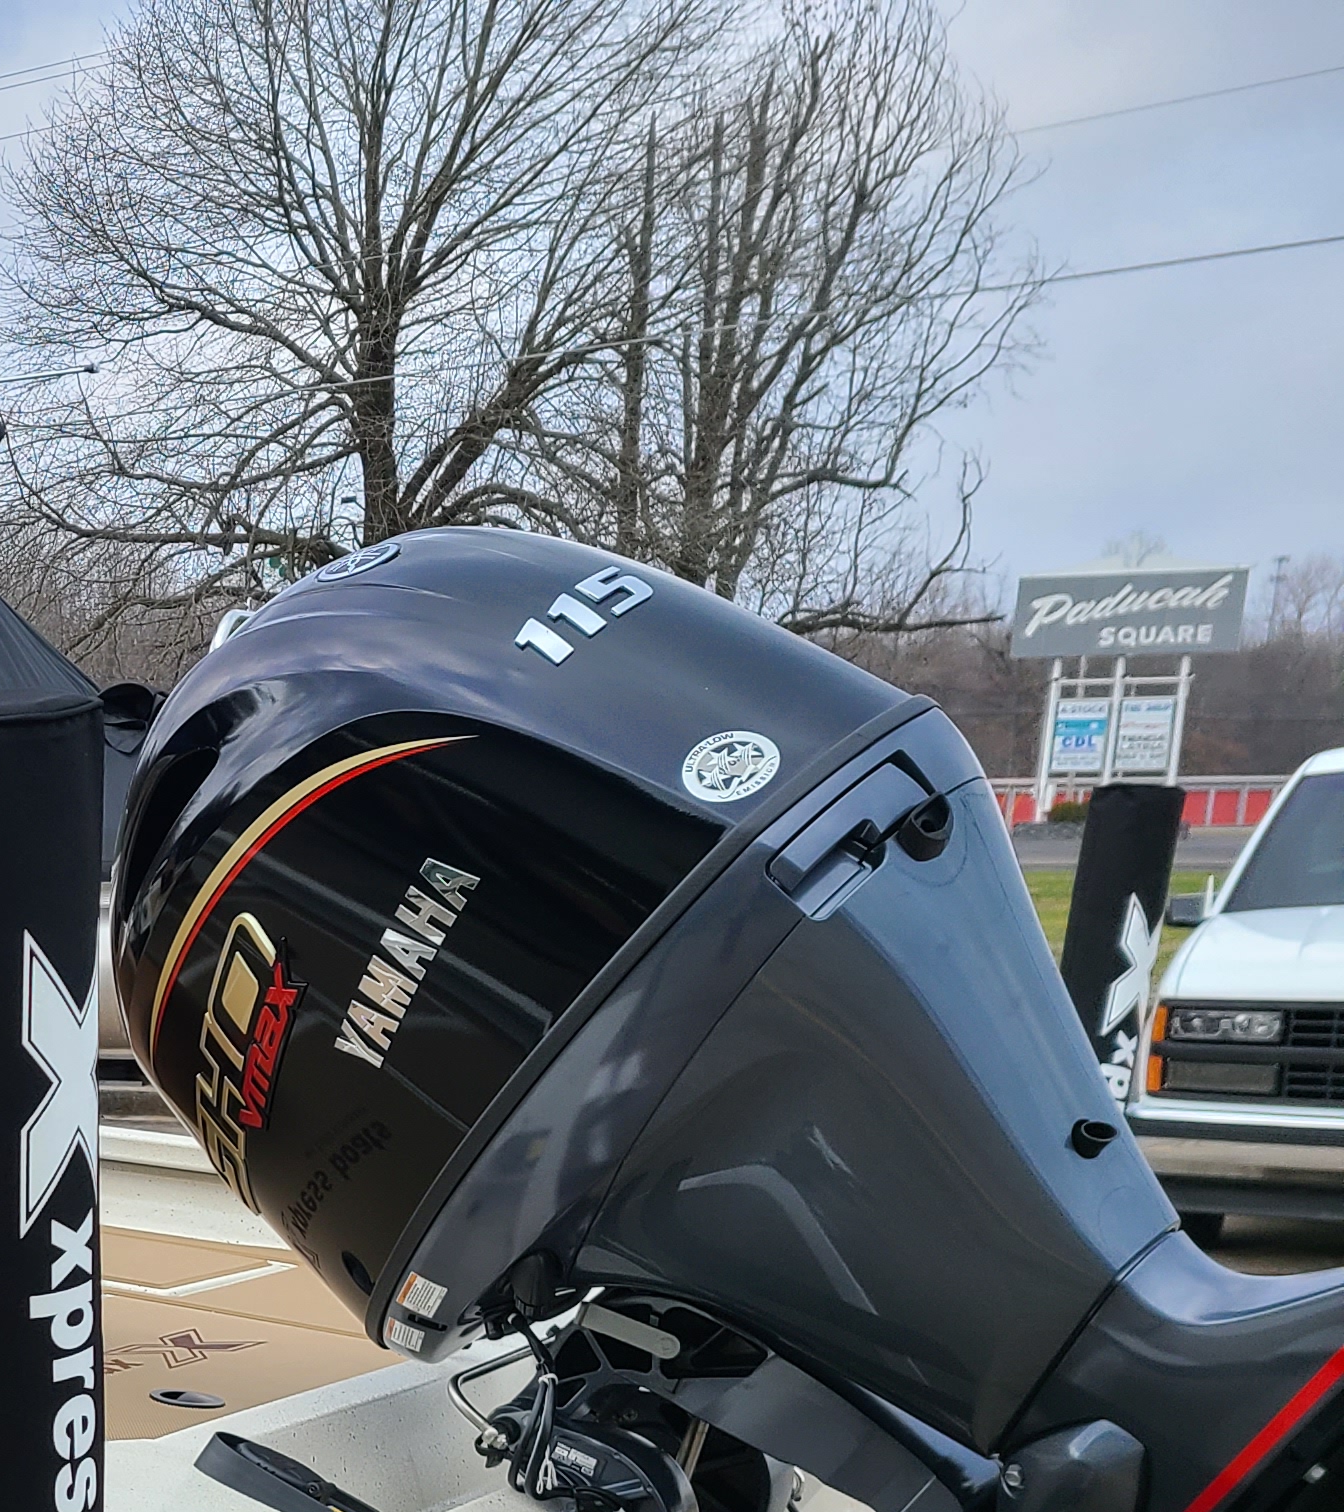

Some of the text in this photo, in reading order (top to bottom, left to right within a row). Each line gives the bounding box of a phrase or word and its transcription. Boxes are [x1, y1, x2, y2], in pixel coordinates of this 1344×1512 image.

[514, 565, 654, 667] 115
[1025, 573, 1234, 638] Paducah
[1097, 624, 1214, 648] SQUARE
[334, 857, 481, 1069] YAMAHA
